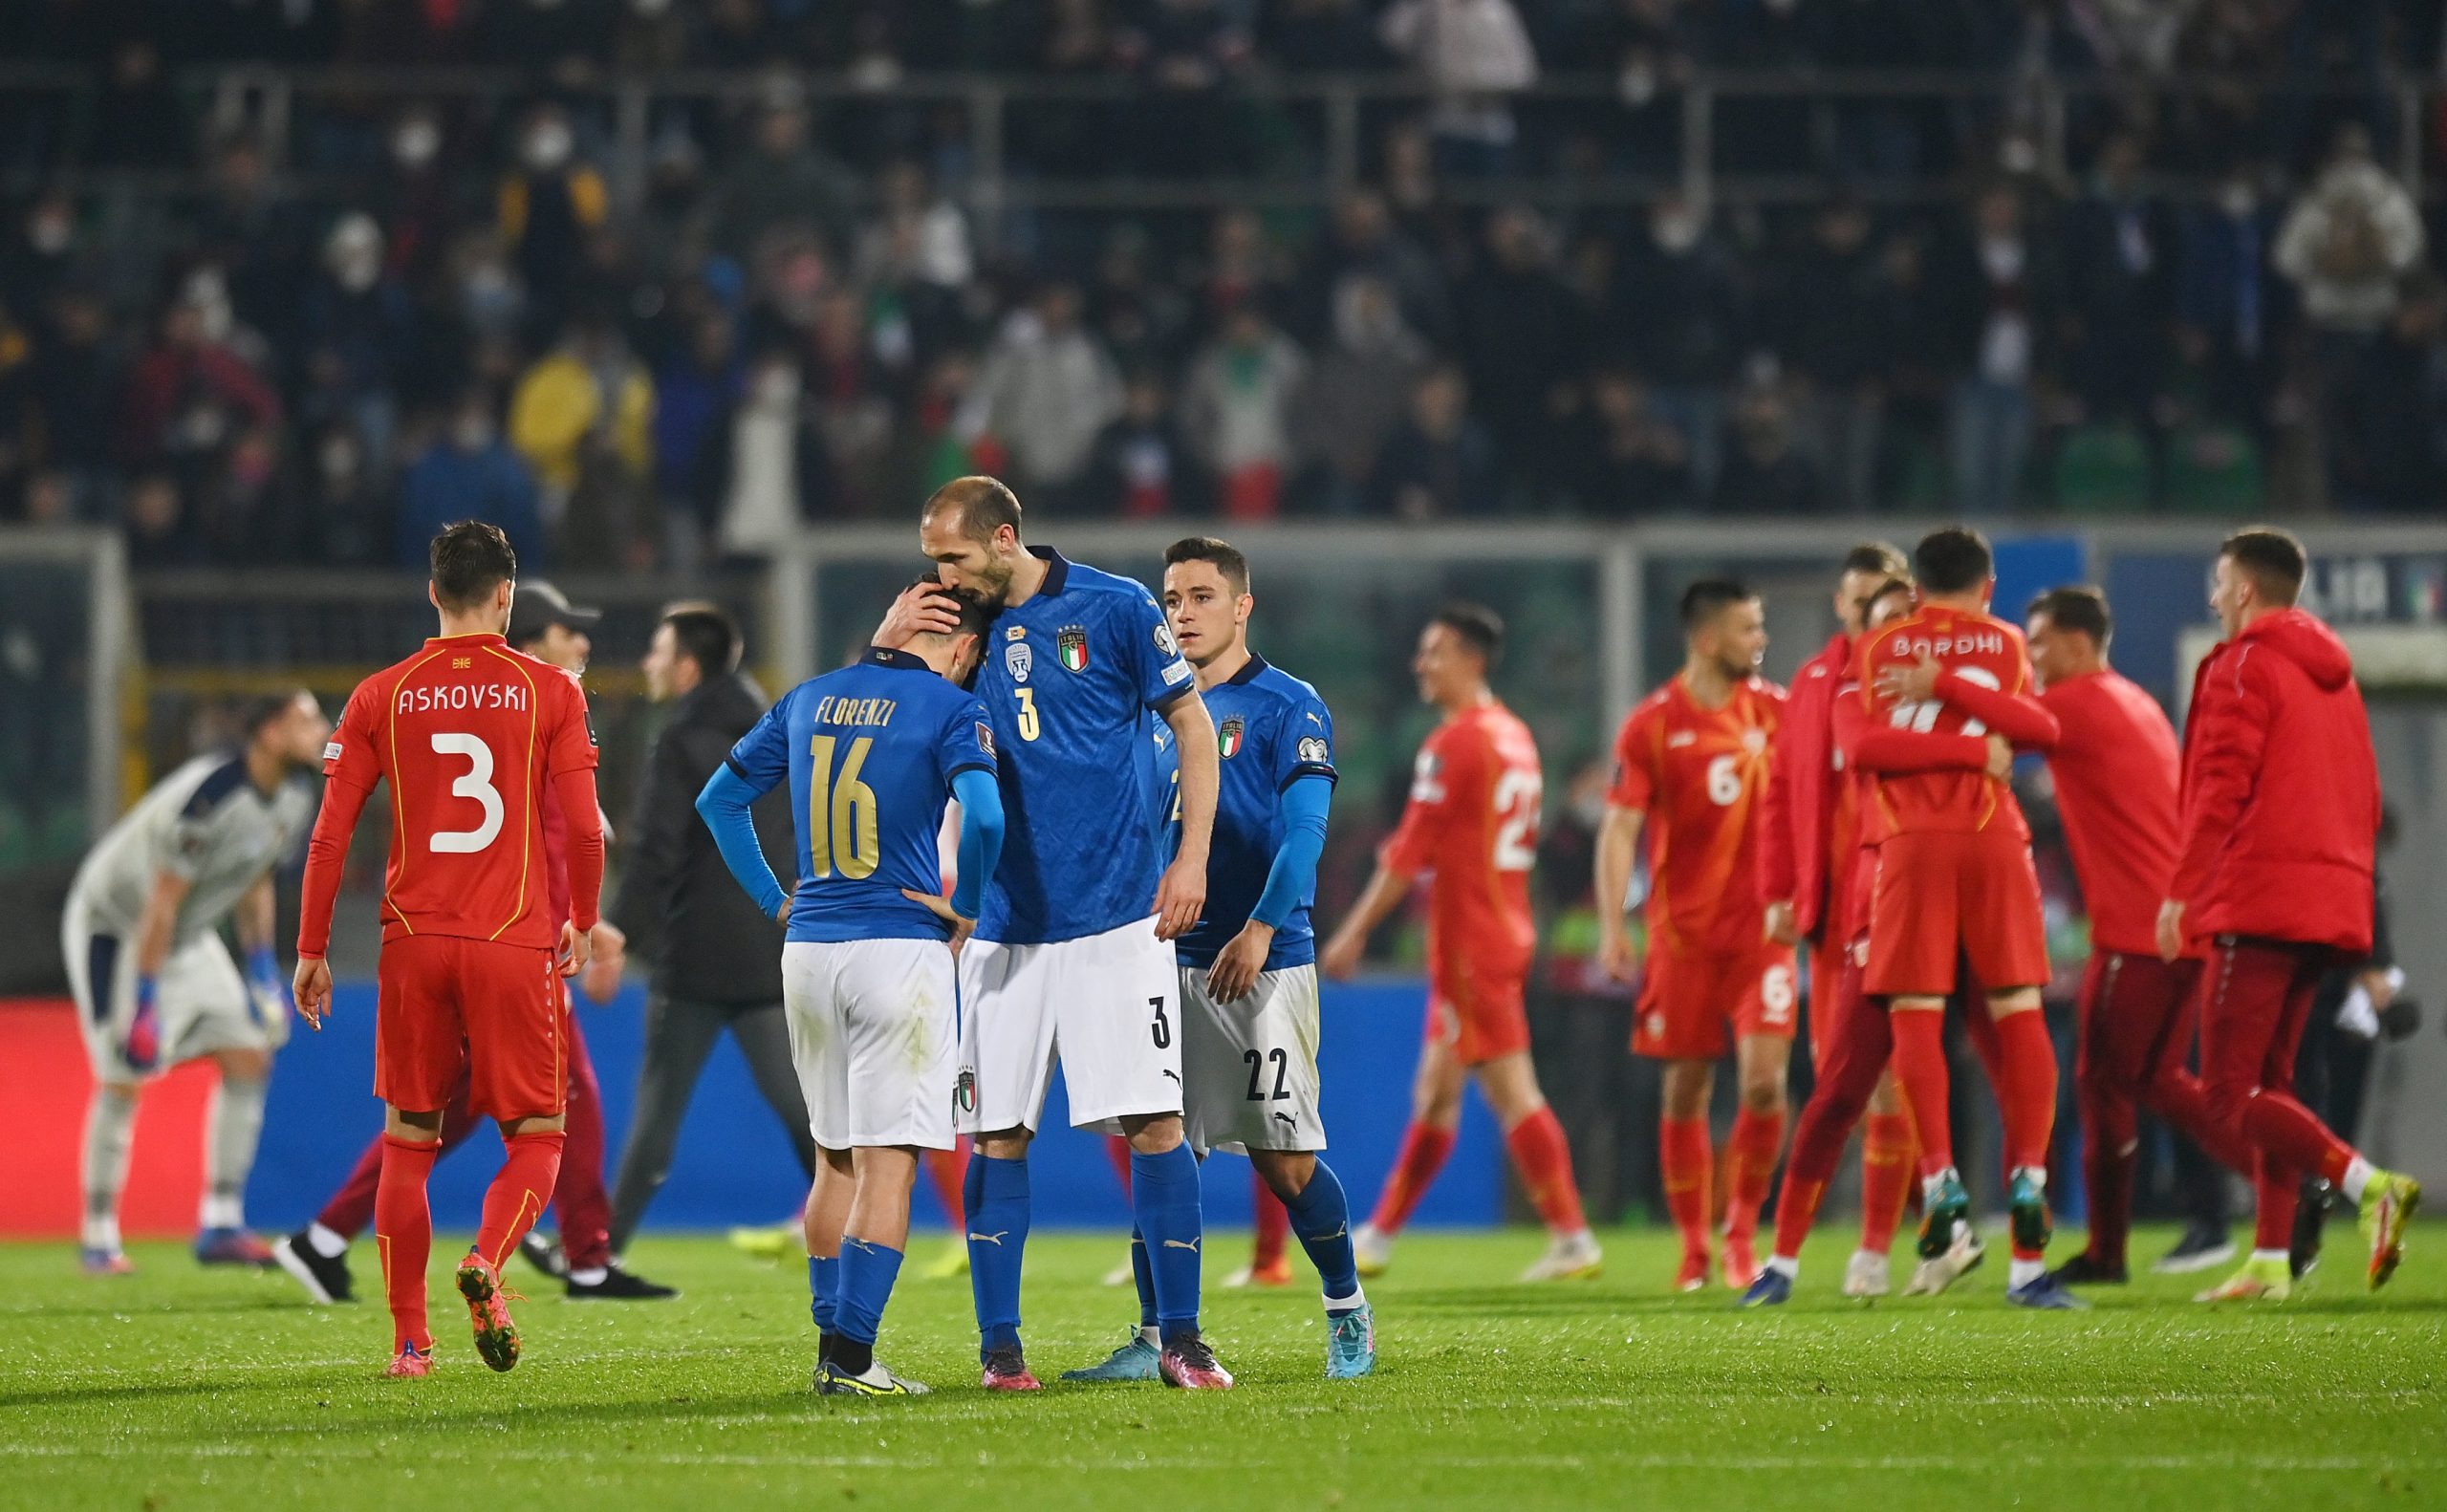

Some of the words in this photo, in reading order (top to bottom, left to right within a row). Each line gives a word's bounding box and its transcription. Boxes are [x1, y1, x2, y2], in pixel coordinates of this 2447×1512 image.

[398, 683, 527, 715] ASKOVSKI
[813, 696, 897, 727] FLORENZI
[1014, 687, 1040, 742] 3
[429, 732, 505, 853] 3
[1706, 753, 1743, 807] 6
[810, 734, 879, 880] 16
[1761, 963, 1794, 1013] 6
[1148, 996, 1171, 1049] 3
[1244, 1048, 1290, 1101] 22
